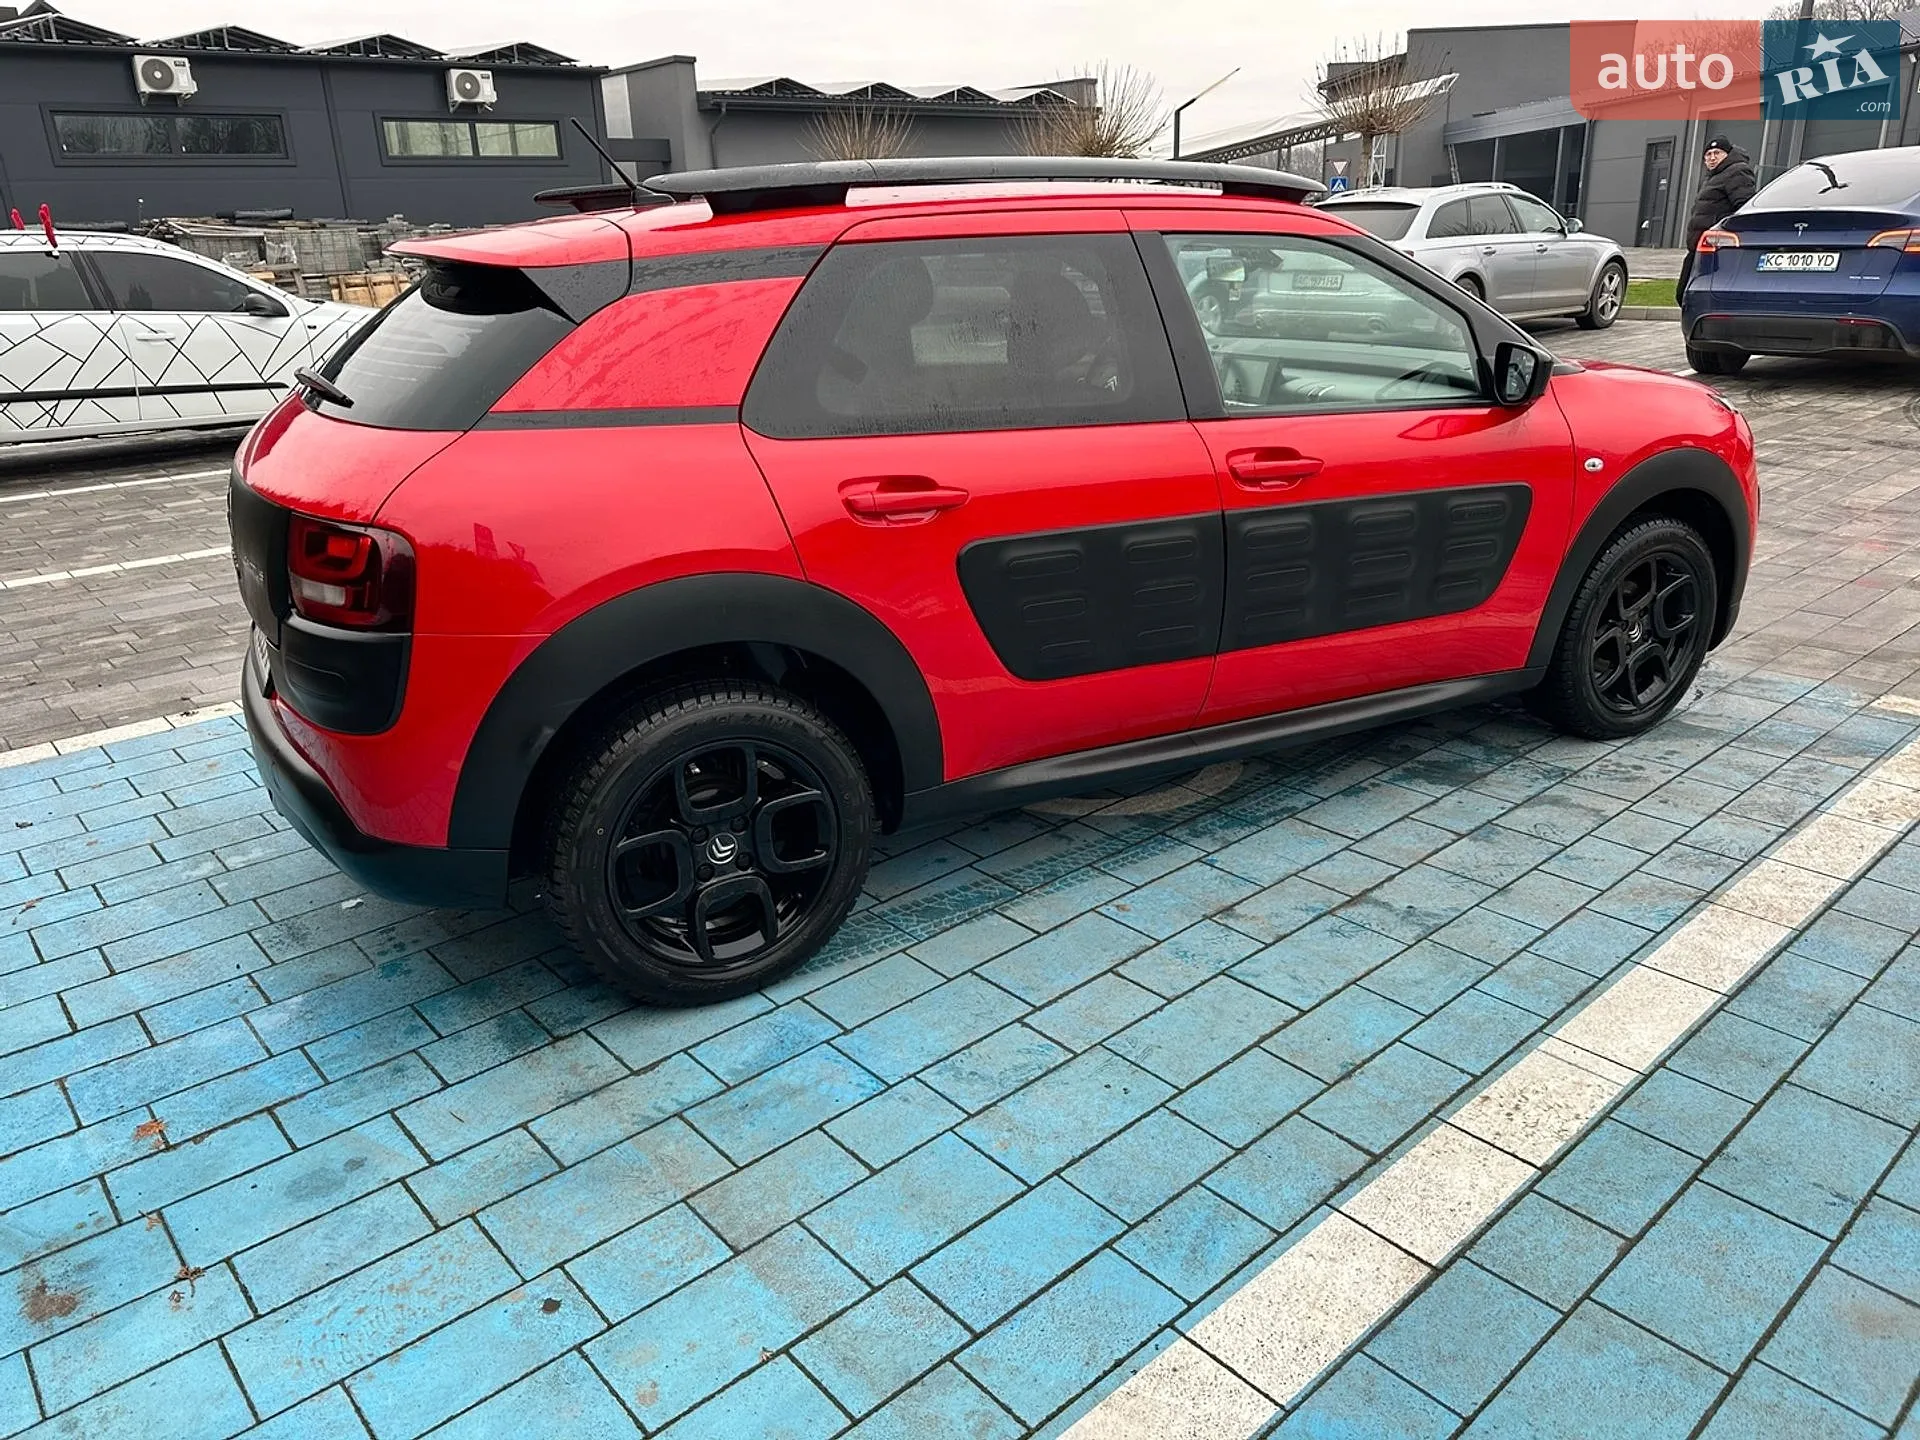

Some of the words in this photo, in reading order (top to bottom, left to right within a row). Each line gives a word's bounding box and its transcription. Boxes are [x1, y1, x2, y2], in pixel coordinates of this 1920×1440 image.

[1765, 254, 1784, 267] KC
[1787, 254, 1814, 267] 1010
[1817, 254, 1835, 267] YD
